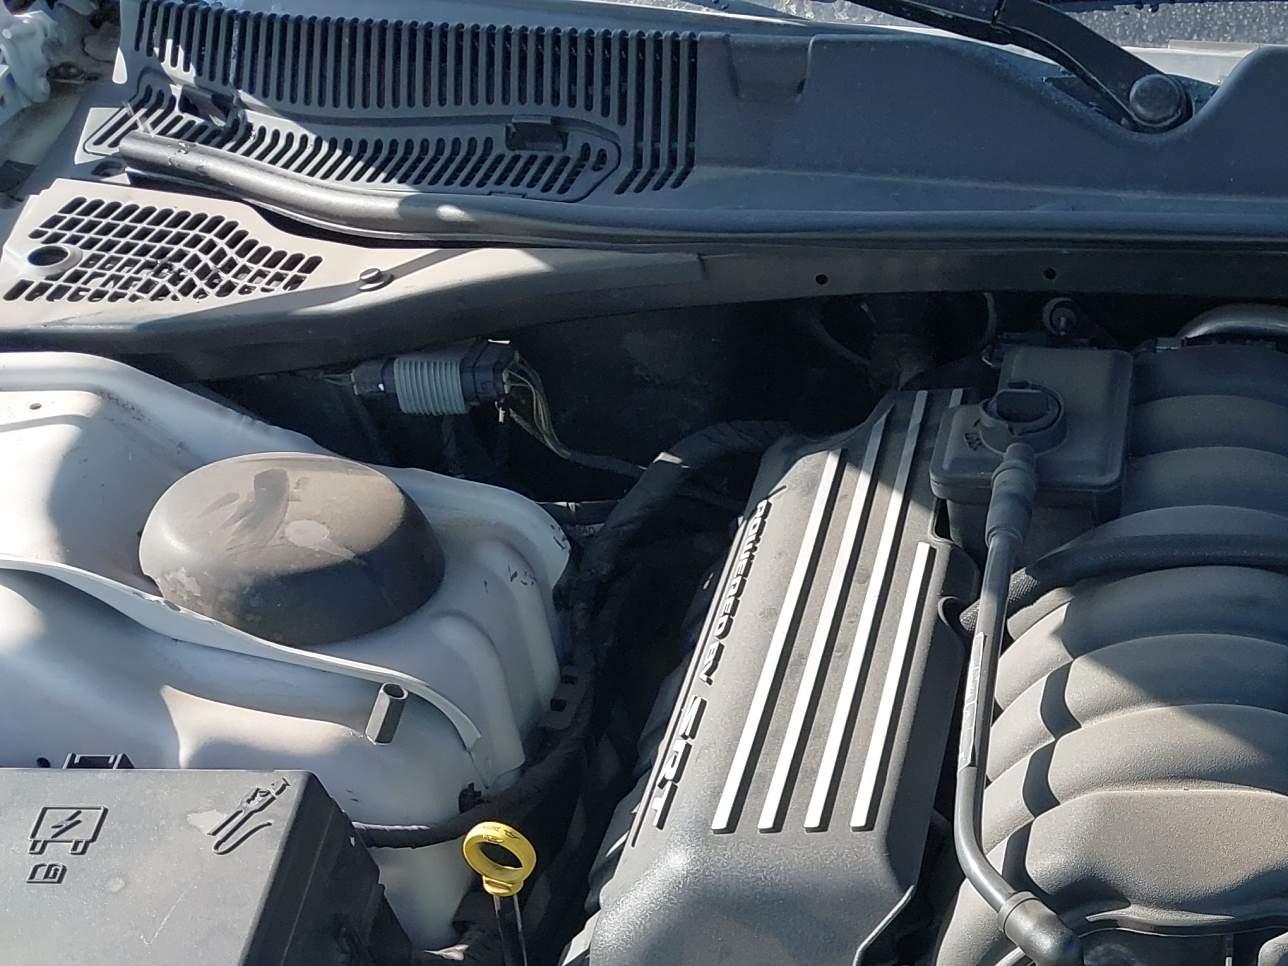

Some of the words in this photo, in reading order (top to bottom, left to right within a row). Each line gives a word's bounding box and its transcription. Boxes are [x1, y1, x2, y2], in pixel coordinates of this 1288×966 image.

[714, 499, 772, 640] POWERED
[700, 641, 726, 686] BY
[652, 696, 708, 831] SRT
